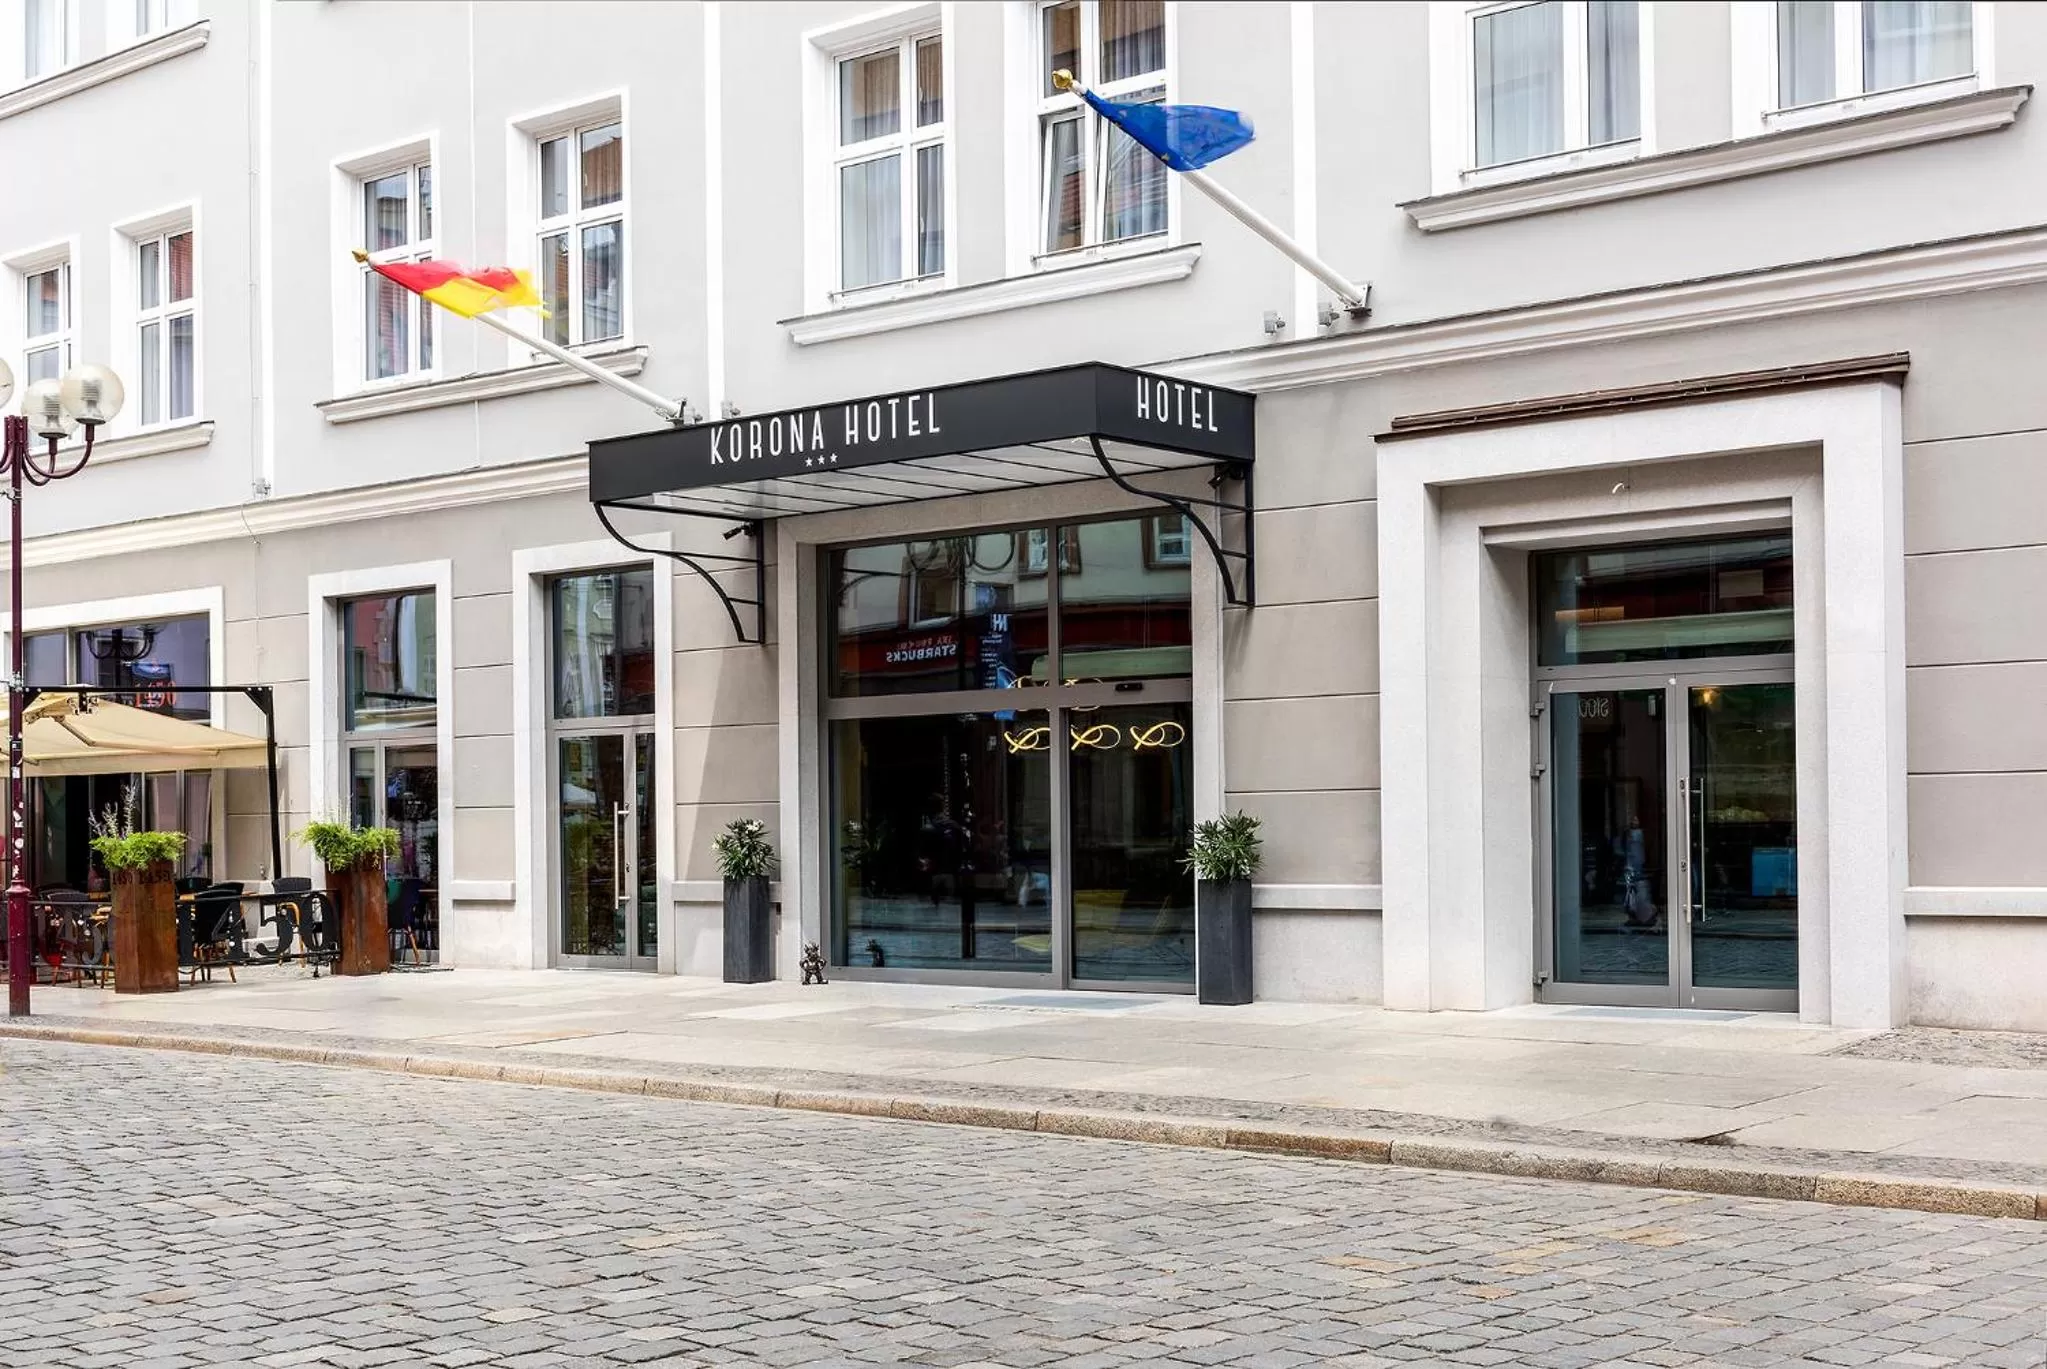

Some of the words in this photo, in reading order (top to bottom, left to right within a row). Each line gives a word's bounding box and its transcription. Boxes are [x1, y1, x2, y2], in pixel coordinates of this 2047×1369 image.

[710, 410, 824, 465] KORONA
[845, 392, 940, 445] HOTEL
[1137, 376, 1218, 432] HOTEL
[177, 892, 341, 965] 1450
